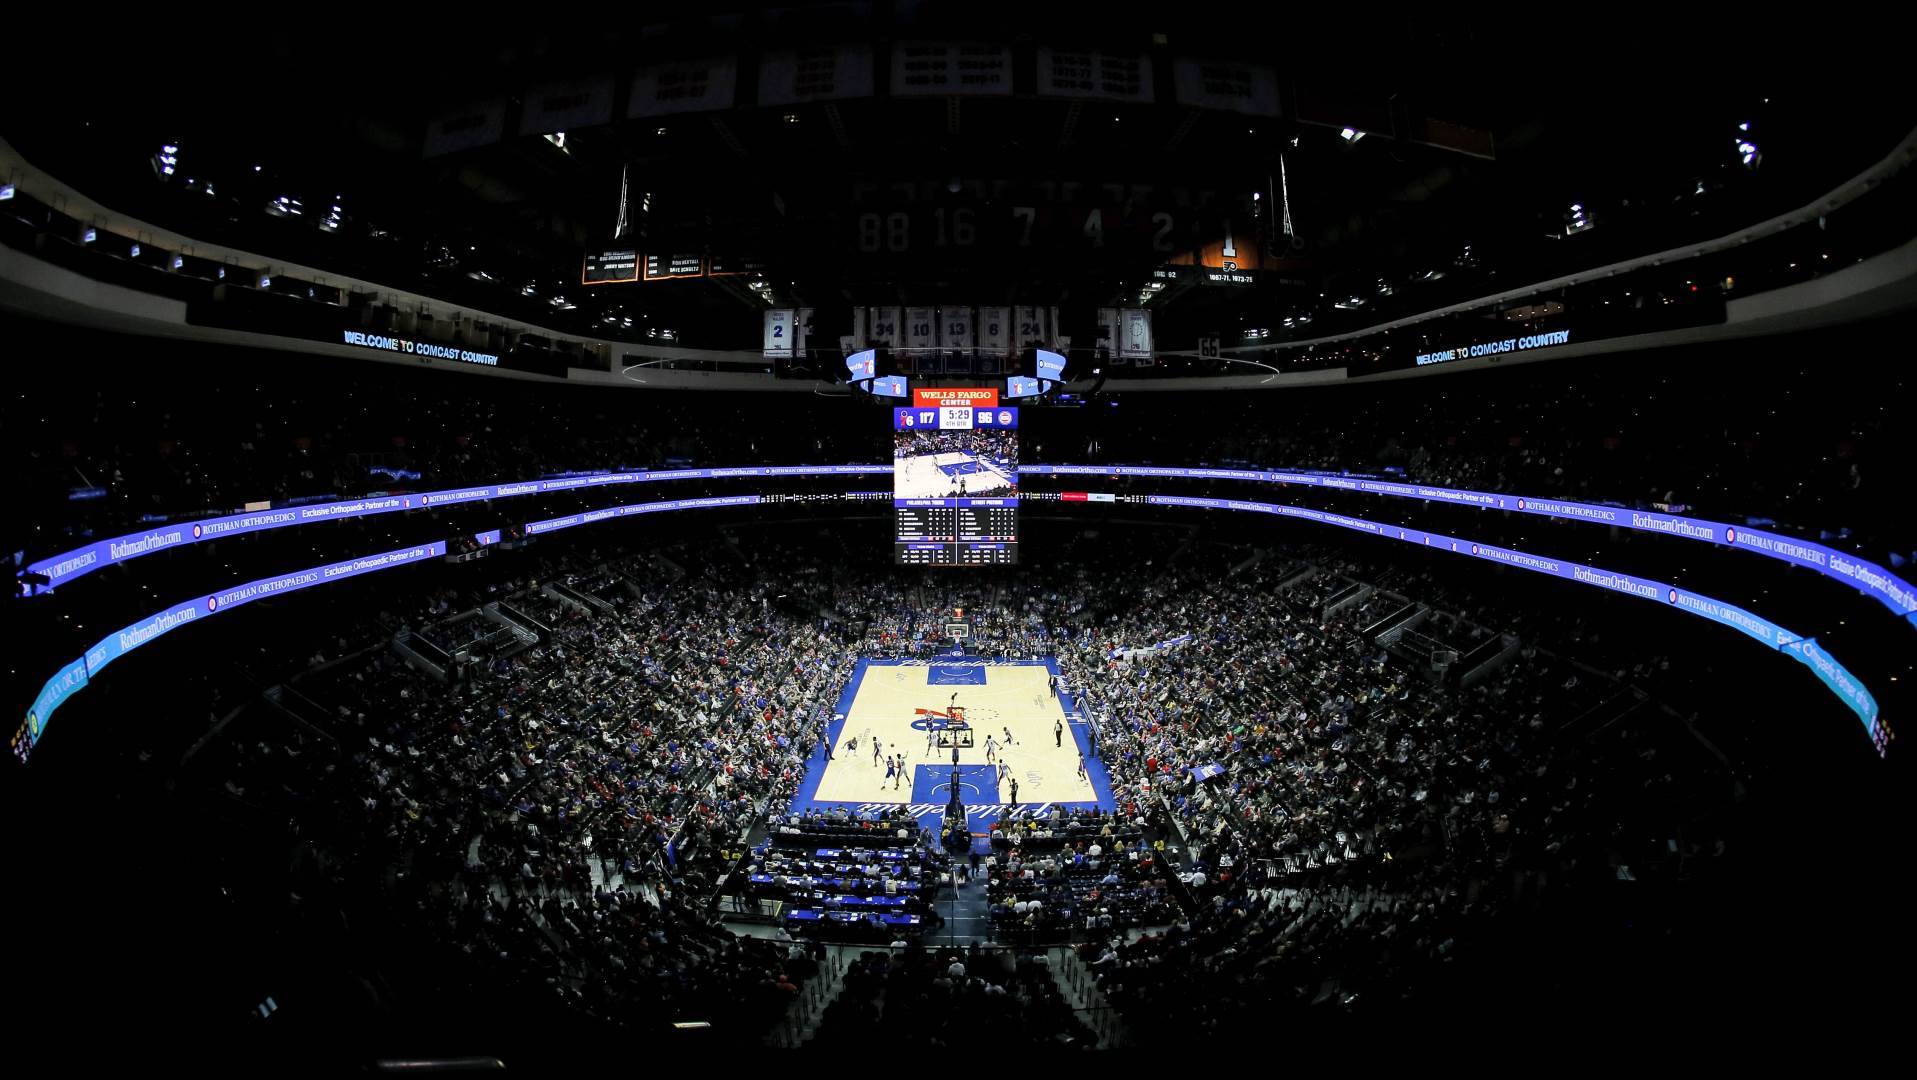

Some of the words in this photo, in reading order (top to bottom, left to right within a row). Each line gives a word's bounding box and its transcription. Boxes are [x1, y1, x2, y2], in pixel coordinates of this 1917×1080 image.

[857, 211, 911, 254] 88
[935, 207, 976, 247] 16
[1012, 207, 1036, 248] 7
[1082, 207, 1104, 248] 4
[1152, 212, 1174, 252] 2
[1222, 217, 1237, 257] 1
[774, 325, 783, 338] 2
[876, 323, 894, 336] 34
[913, 323, 929, 337] 10
[950, 323, 965, 336] 13
[1022, 323, 1040, 336] 24
[344, 330, 399, 351] WELCOME
[400, 339, 413, 352] TO
[416, 342, 461, 360] COMCAST
[461, 350, 498, 366] COUNTRY
[1416, 350, 1456, 366] WELCOME
[1457, 347, 1469, 359] TO
[1470, 339, 1516, 357] COMCAST
[1518, 330, 1570, 350] COUNTRY
[920, 391, 956, 399] WELLS
[957, 391, 992, 399] FARGO
[919, 412, 935, 424] 117
[948, 410, 970, 420] 5:29
[977, 412, 993, 424] 96
[302, 506, 329, 518] Exclusive
[330, 502, 365, 514] Orthopaedic
[365, 501, 384, 510] Partner
[1525, 501, 1560, 513] ROTHMAN
[1561, 503, 1615, 521] ORTHOPAEDICS
[203, 521, 240, 535] ROTHMAN
[240, 512, 296, 528] ORTHOPAEDICS
[1632, 513, 1713, 540] RothmanOrtho.com
[111, 533, 182, 560] RothmanOrtho.com
[1479, 547, 1510, 561] ROTHMAN
[1510, 553, 1559, 572] ORTHOPAEDICS
[1736, 532, 1773, 551] ROTHMAN
[1773, 539, 1826, 566] ORTHOPAEDICS
[324, 564, 353, 577] Exclusive
[353, 556, 389, 571] Orthopaedic
[389, 552, 408, 562] Partner
[409, 550, 415, 559] of
[415, 549, 424, 557] the
[1829, 555, 1854, 577] Exclusive
[218, 585, 257, 607] ROTHMAN
[258, 572, 318, 594] ORTHOPAEDICS
[1574, 566, 1658, 598] RothmanOrtho.com
[119, 606, 197, 652] RothmanOrtho.com
[1677, 594, 1720, 617] ROTHMAN
[1719, 607, 1771, 640] ORTHOPAEDICS
